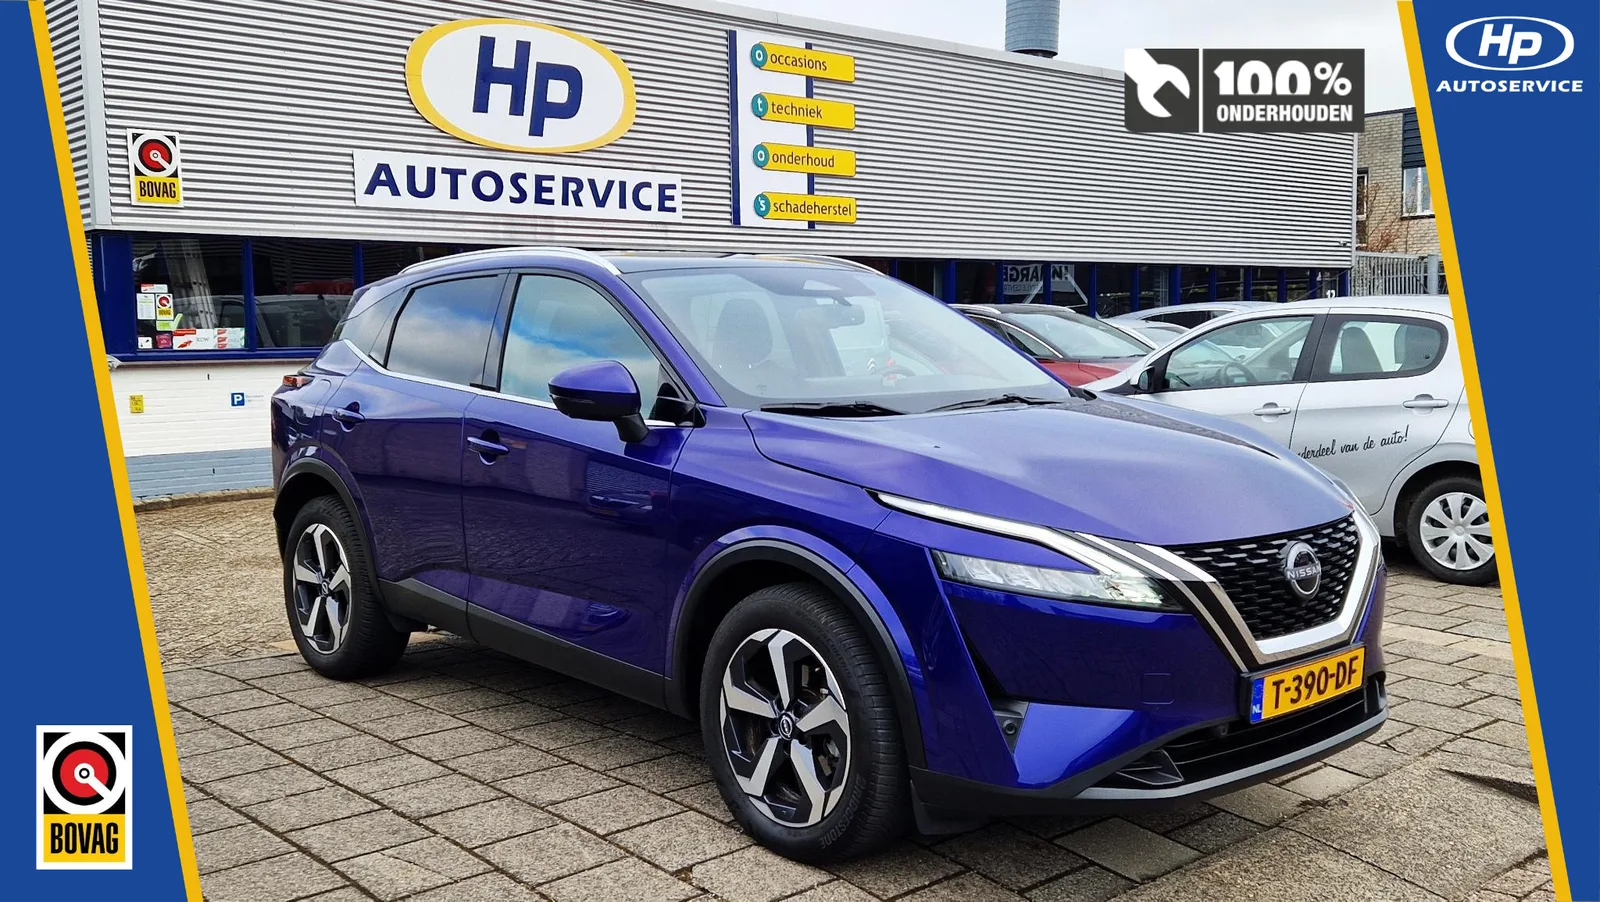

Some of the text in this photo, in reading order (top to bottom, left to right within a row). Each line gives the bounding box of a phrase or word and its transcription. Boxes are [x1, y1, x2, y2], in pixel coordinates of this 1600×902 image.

[770, 52, 828, 72] occasions
[771, 101, 823, 119] techniek
[772, 152, 835, 168] onderhoud
[139, 180, 177, 199] BOVAG
[363, 162, 678, 213] AUTOSERVICE
[773, 200, 852, 217] schadeherstel
[233, 394, 243, 405] P
[1340, 443, 1359, 453] van
[1363, 436, 1376, 450] de
[1380, 424, 1410, 447] auto!
[1286, 563, 1321, 580] NISSAN
[1272, 655, 1359, 710] T-390-DF
[1252, 704, 1262, 715] NL
